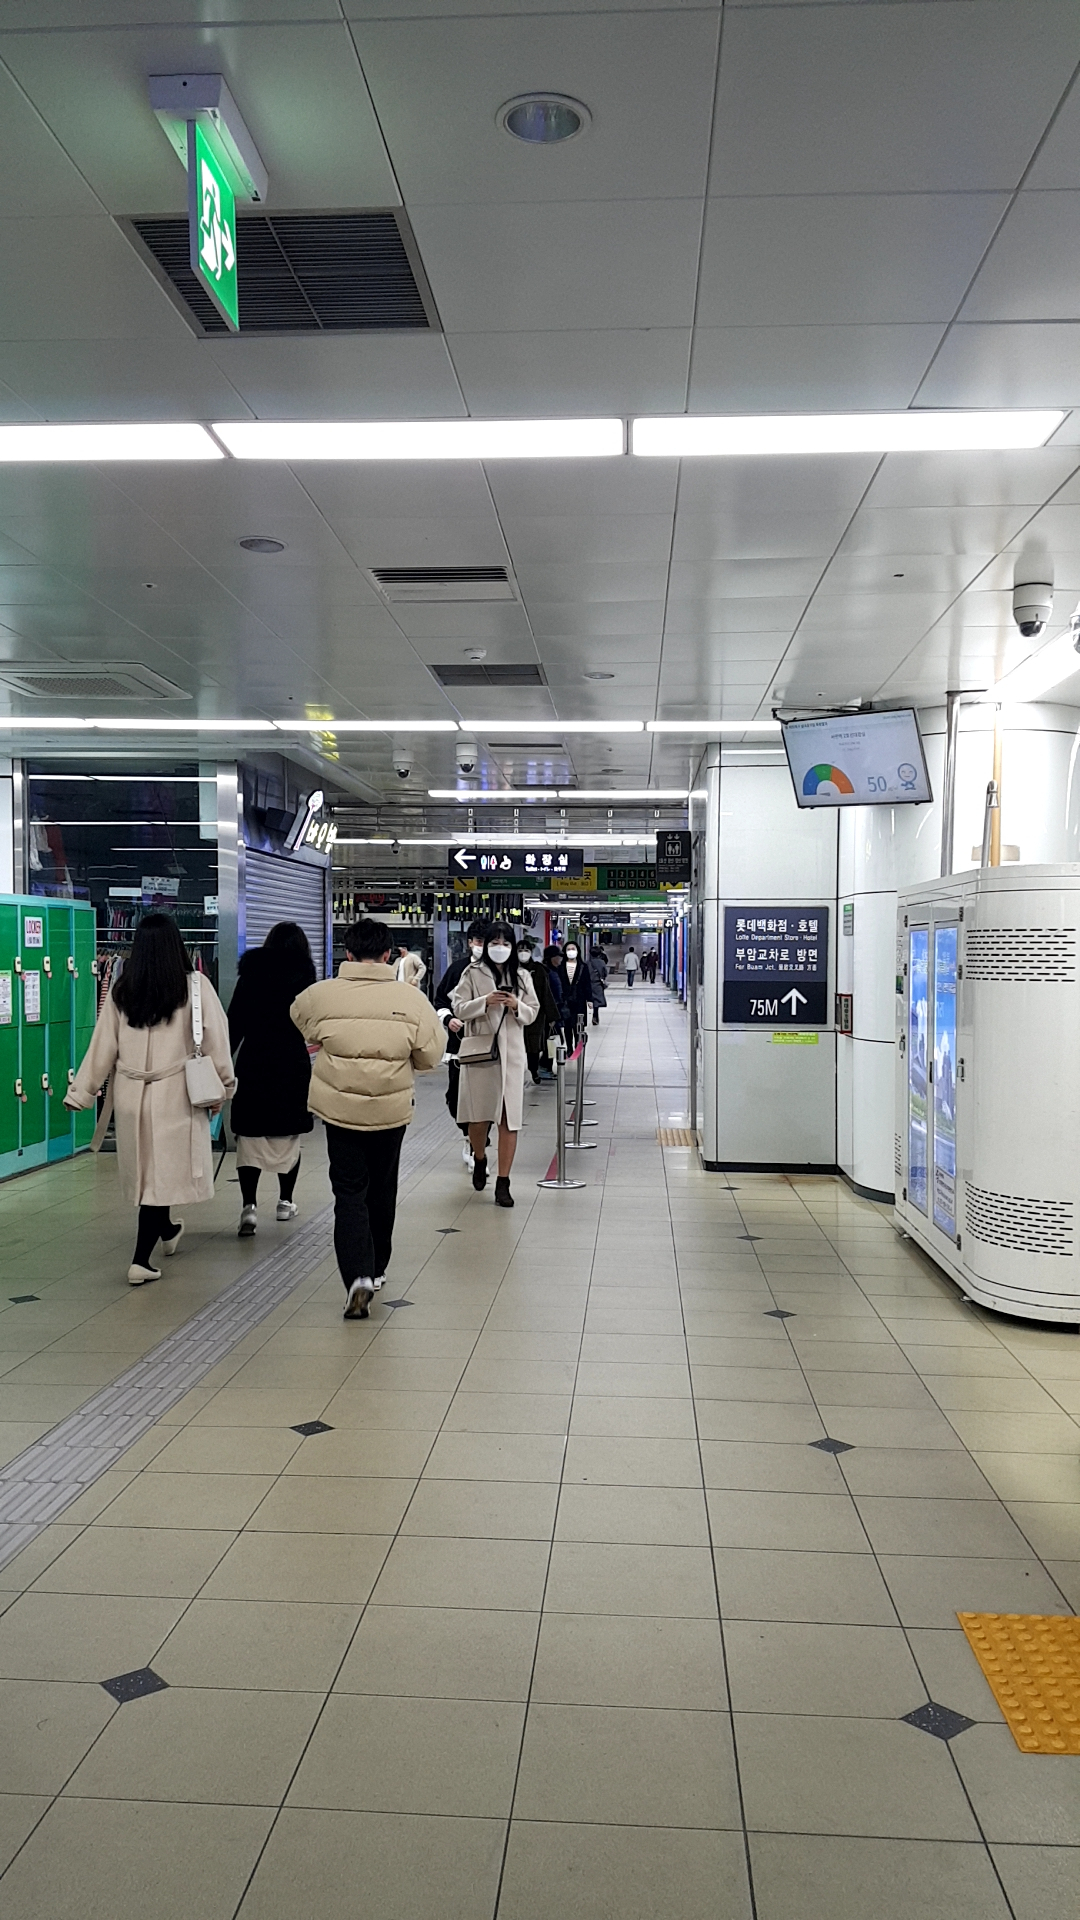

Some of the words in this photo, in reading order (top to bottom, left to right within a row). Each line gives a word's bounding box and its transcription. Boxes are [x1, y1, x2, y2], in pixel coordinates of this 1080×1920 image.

[867, 775, 887, 792] 50
[735, 918, 787, 932] 롯데백화점
[797, 919, 819, 933] 호텔
[735, 947, 790, 962] 부암교차로
[796, 948, 818, 962] 방면
[735, 963, 744, 971] For
[747, 963, 763, 971] Buam
[749, 999, 778, 1016] 75M
